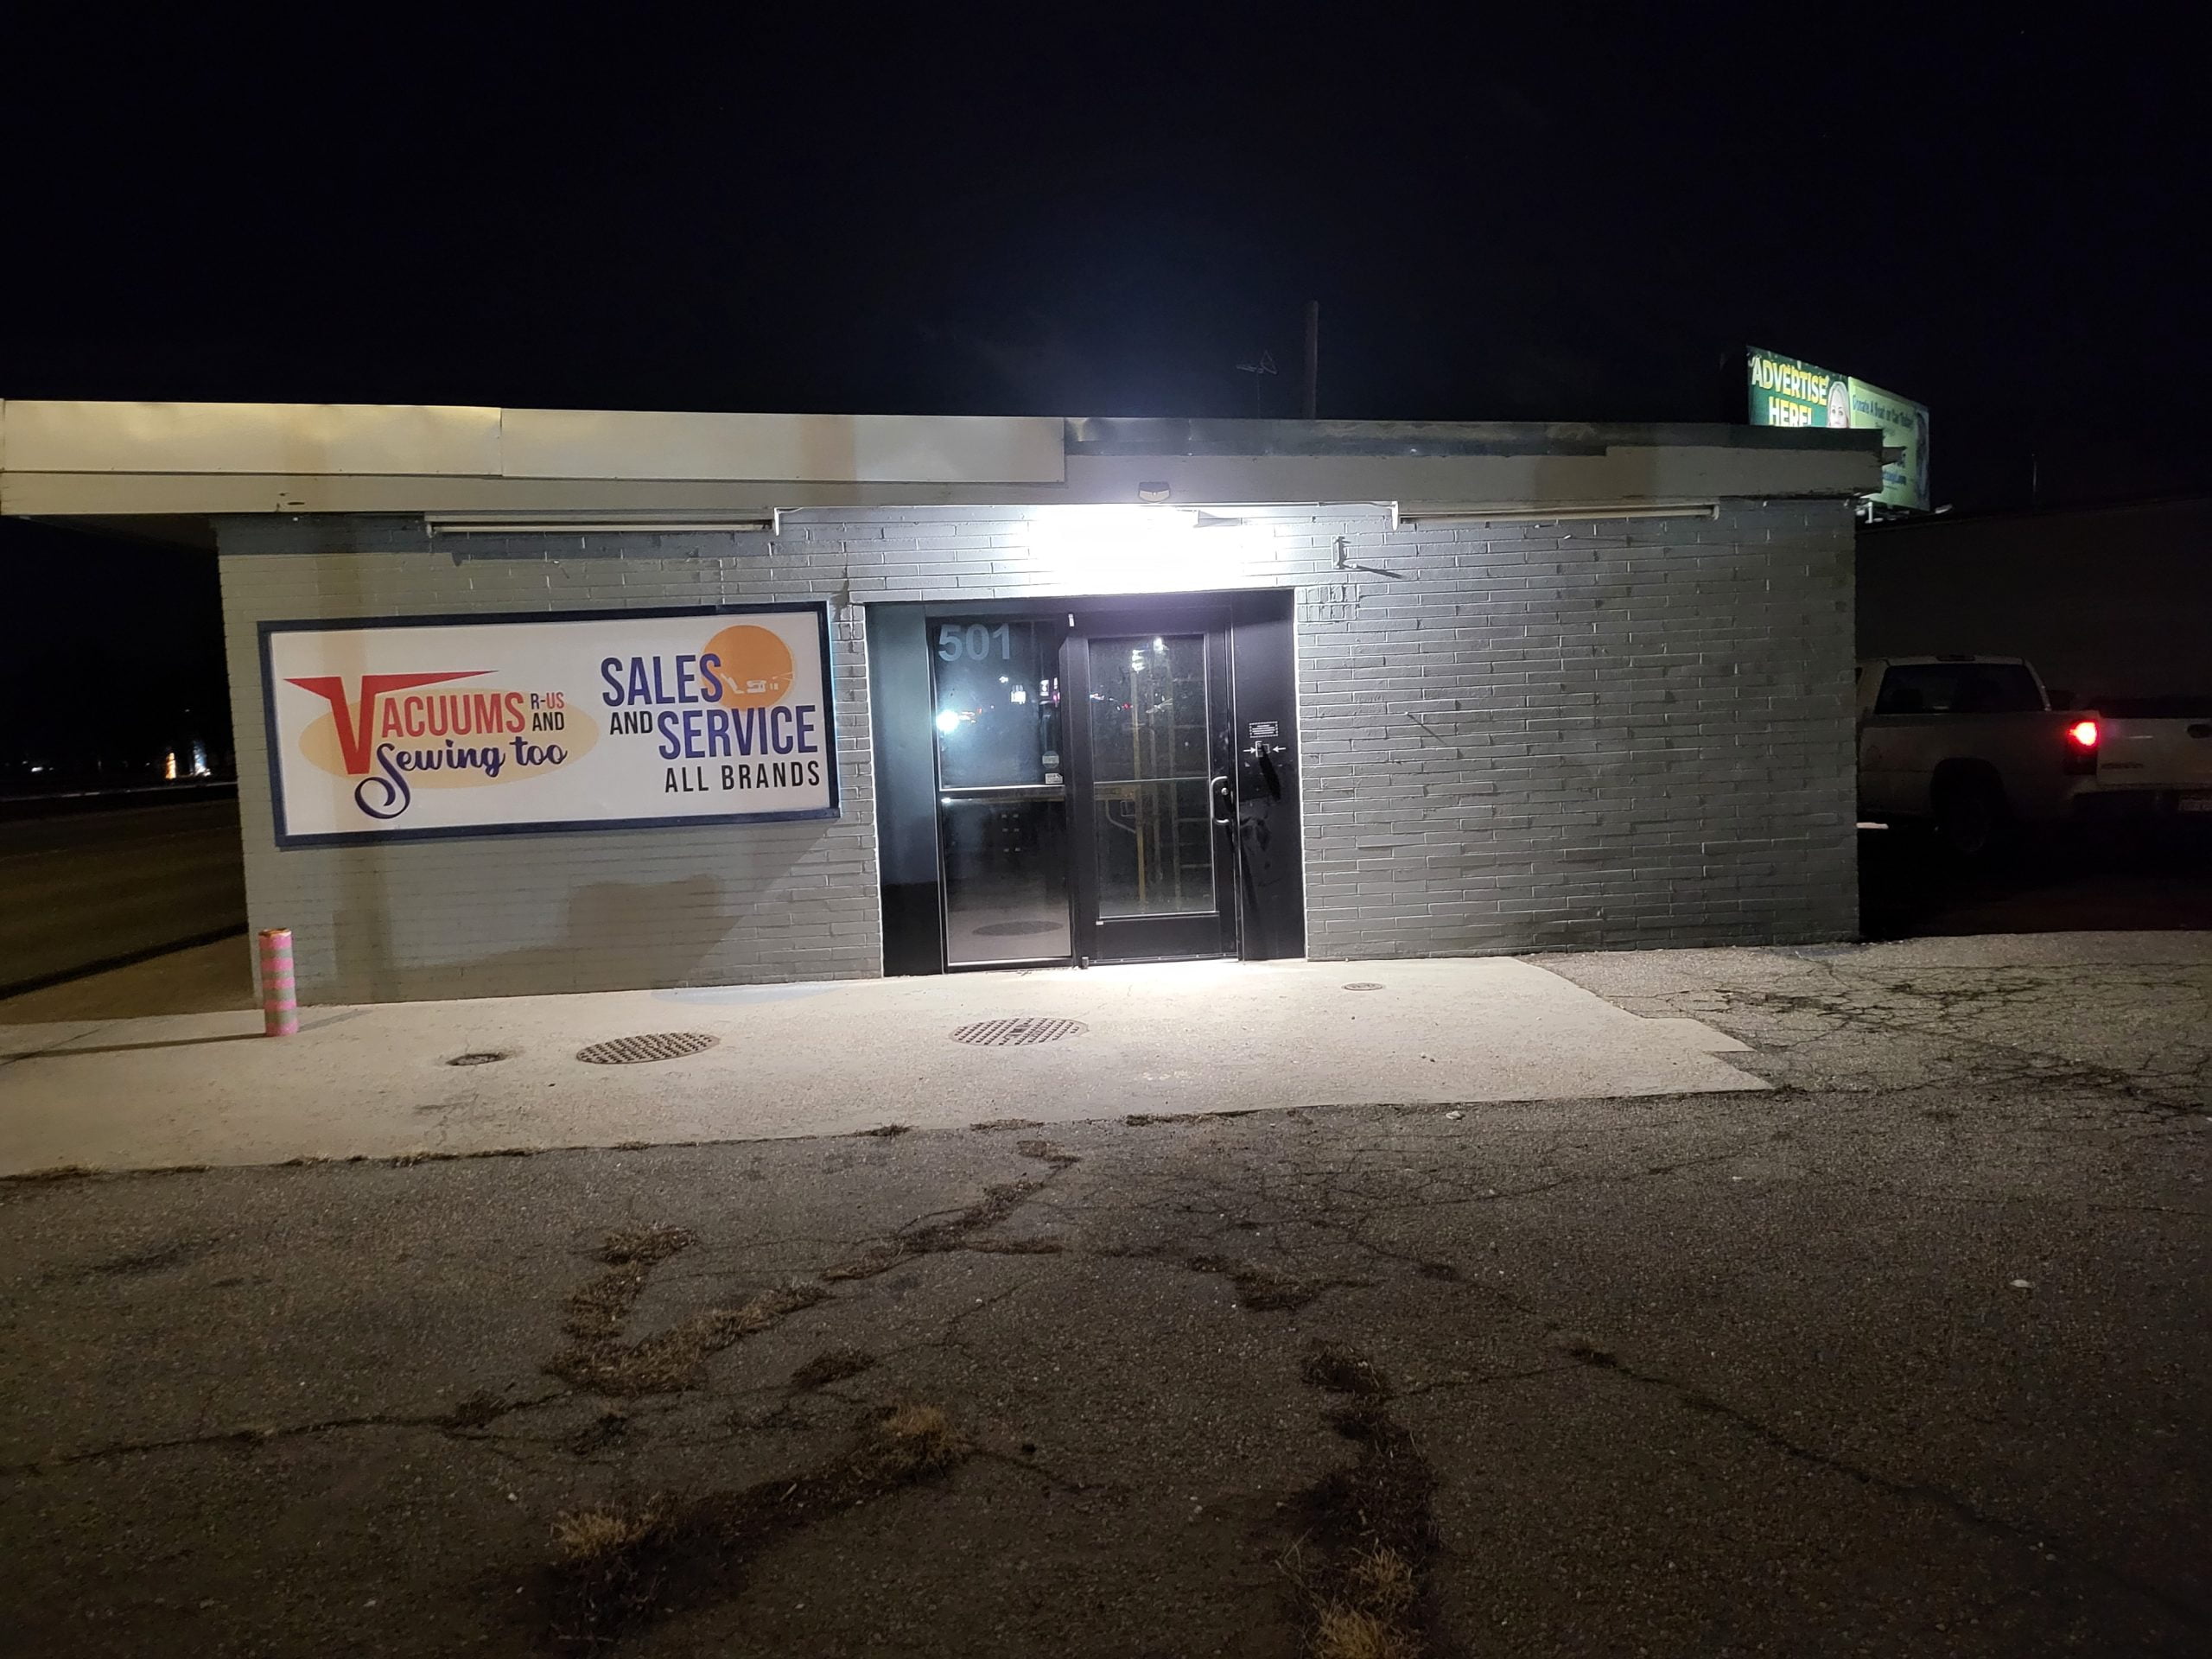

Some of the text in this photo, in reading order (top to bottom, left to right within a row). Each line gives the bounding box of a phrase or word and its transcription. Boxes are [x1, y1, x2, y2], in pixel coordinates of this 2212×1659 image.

[1751, 356, 1827, 406] ADVERTISE
[938, 623, 1010, 662] 501
[530, 691, 564, 709] R-US
[601, 653, 723, 707] SALES
[283, 670, 525, 774] VACUUMS
[531, 711, 564, 732] AND
[609, 705, 818, 760] AND SERVICE
[354, 735, 568, 819] Sewing too
[664, 760, 820, 793] ALL BRANDS
